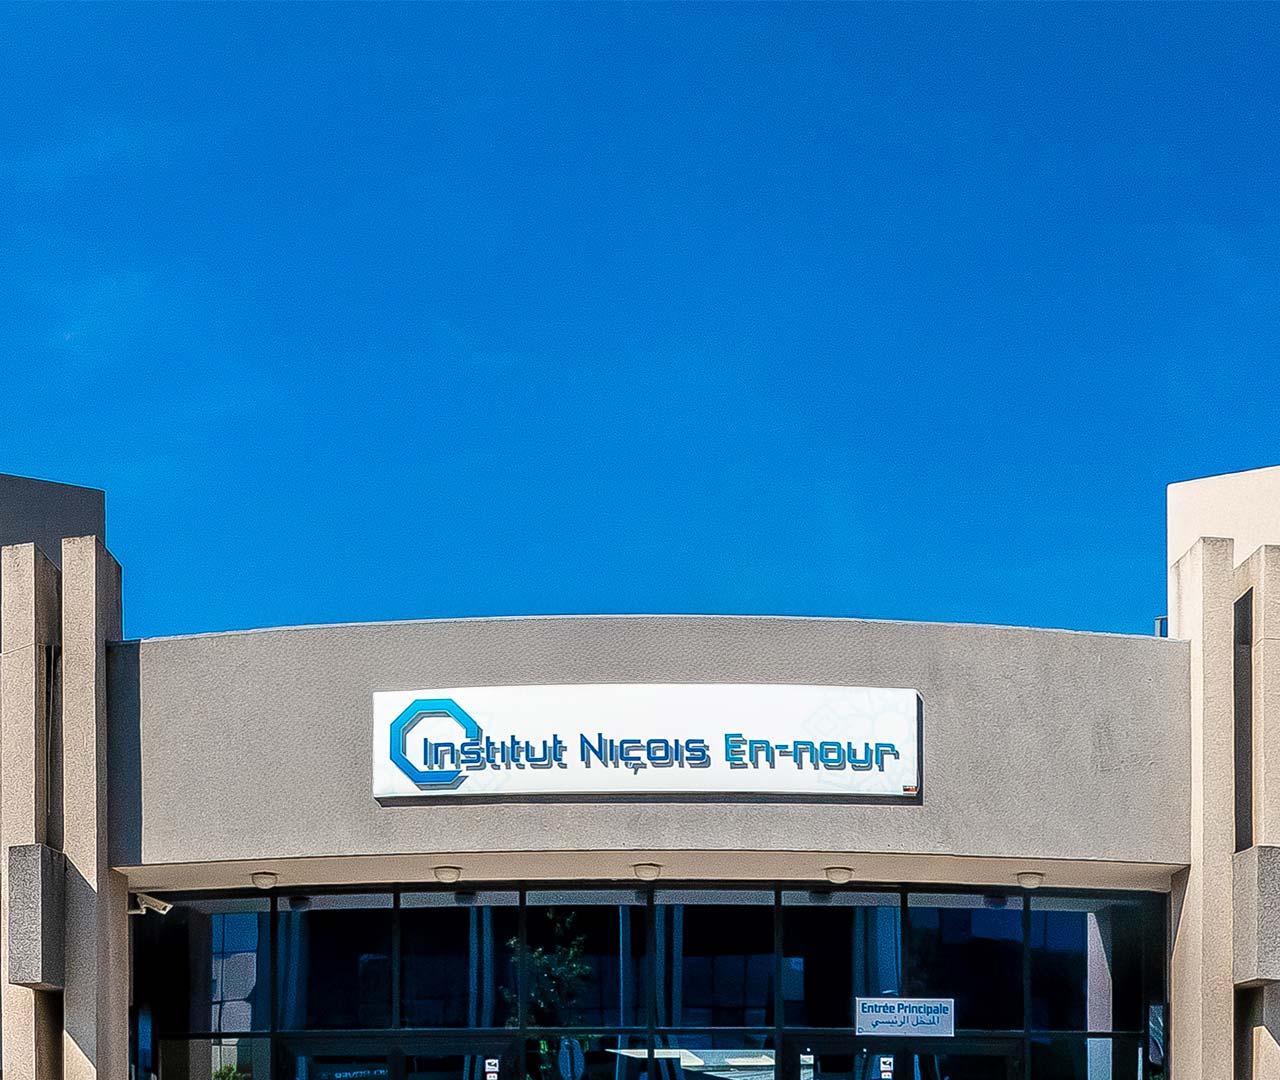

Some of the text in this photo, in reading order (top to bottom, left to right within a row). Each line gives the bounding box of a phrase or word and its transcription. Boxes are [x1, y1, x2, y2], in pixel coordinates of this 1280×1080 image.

[423, 732, 898, 774] Institut Niçois En-nour
[861, 1002, 949, 1016] Entrée Principale
[871, 1016, 940, 1028] المدخل الرئيسي
